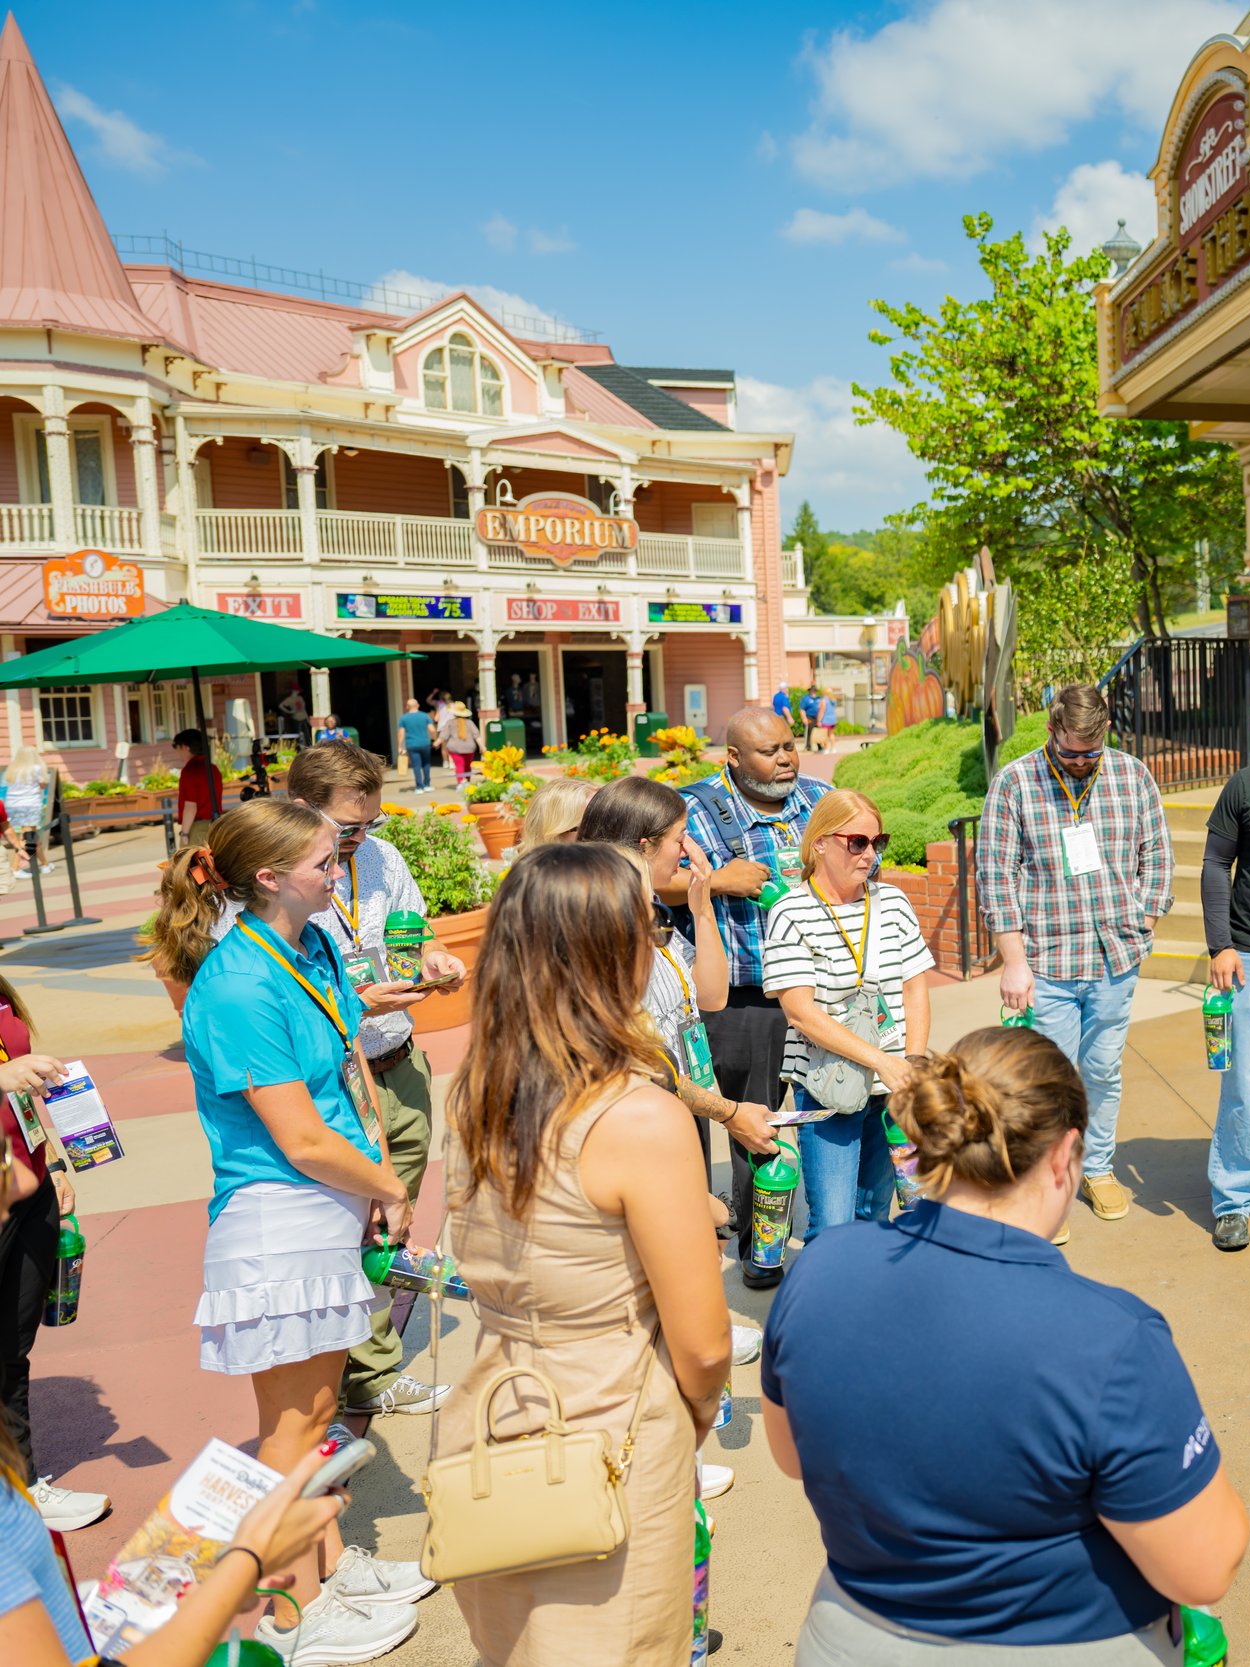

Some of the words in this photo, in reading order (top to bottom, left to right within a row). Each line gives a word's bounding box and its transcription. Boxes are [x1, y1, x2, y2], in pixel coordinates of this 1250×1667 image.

[485, 511, 632, 549] EMPORIUM
[64, 594, 127, 614] PHOTOS
[225, 596, 293, 617] EXIT
[510, 601, 557, 619] SHOP
[578, 602, 617, 621] EXIT
[200, 1471, 255, 1511] HARVES
